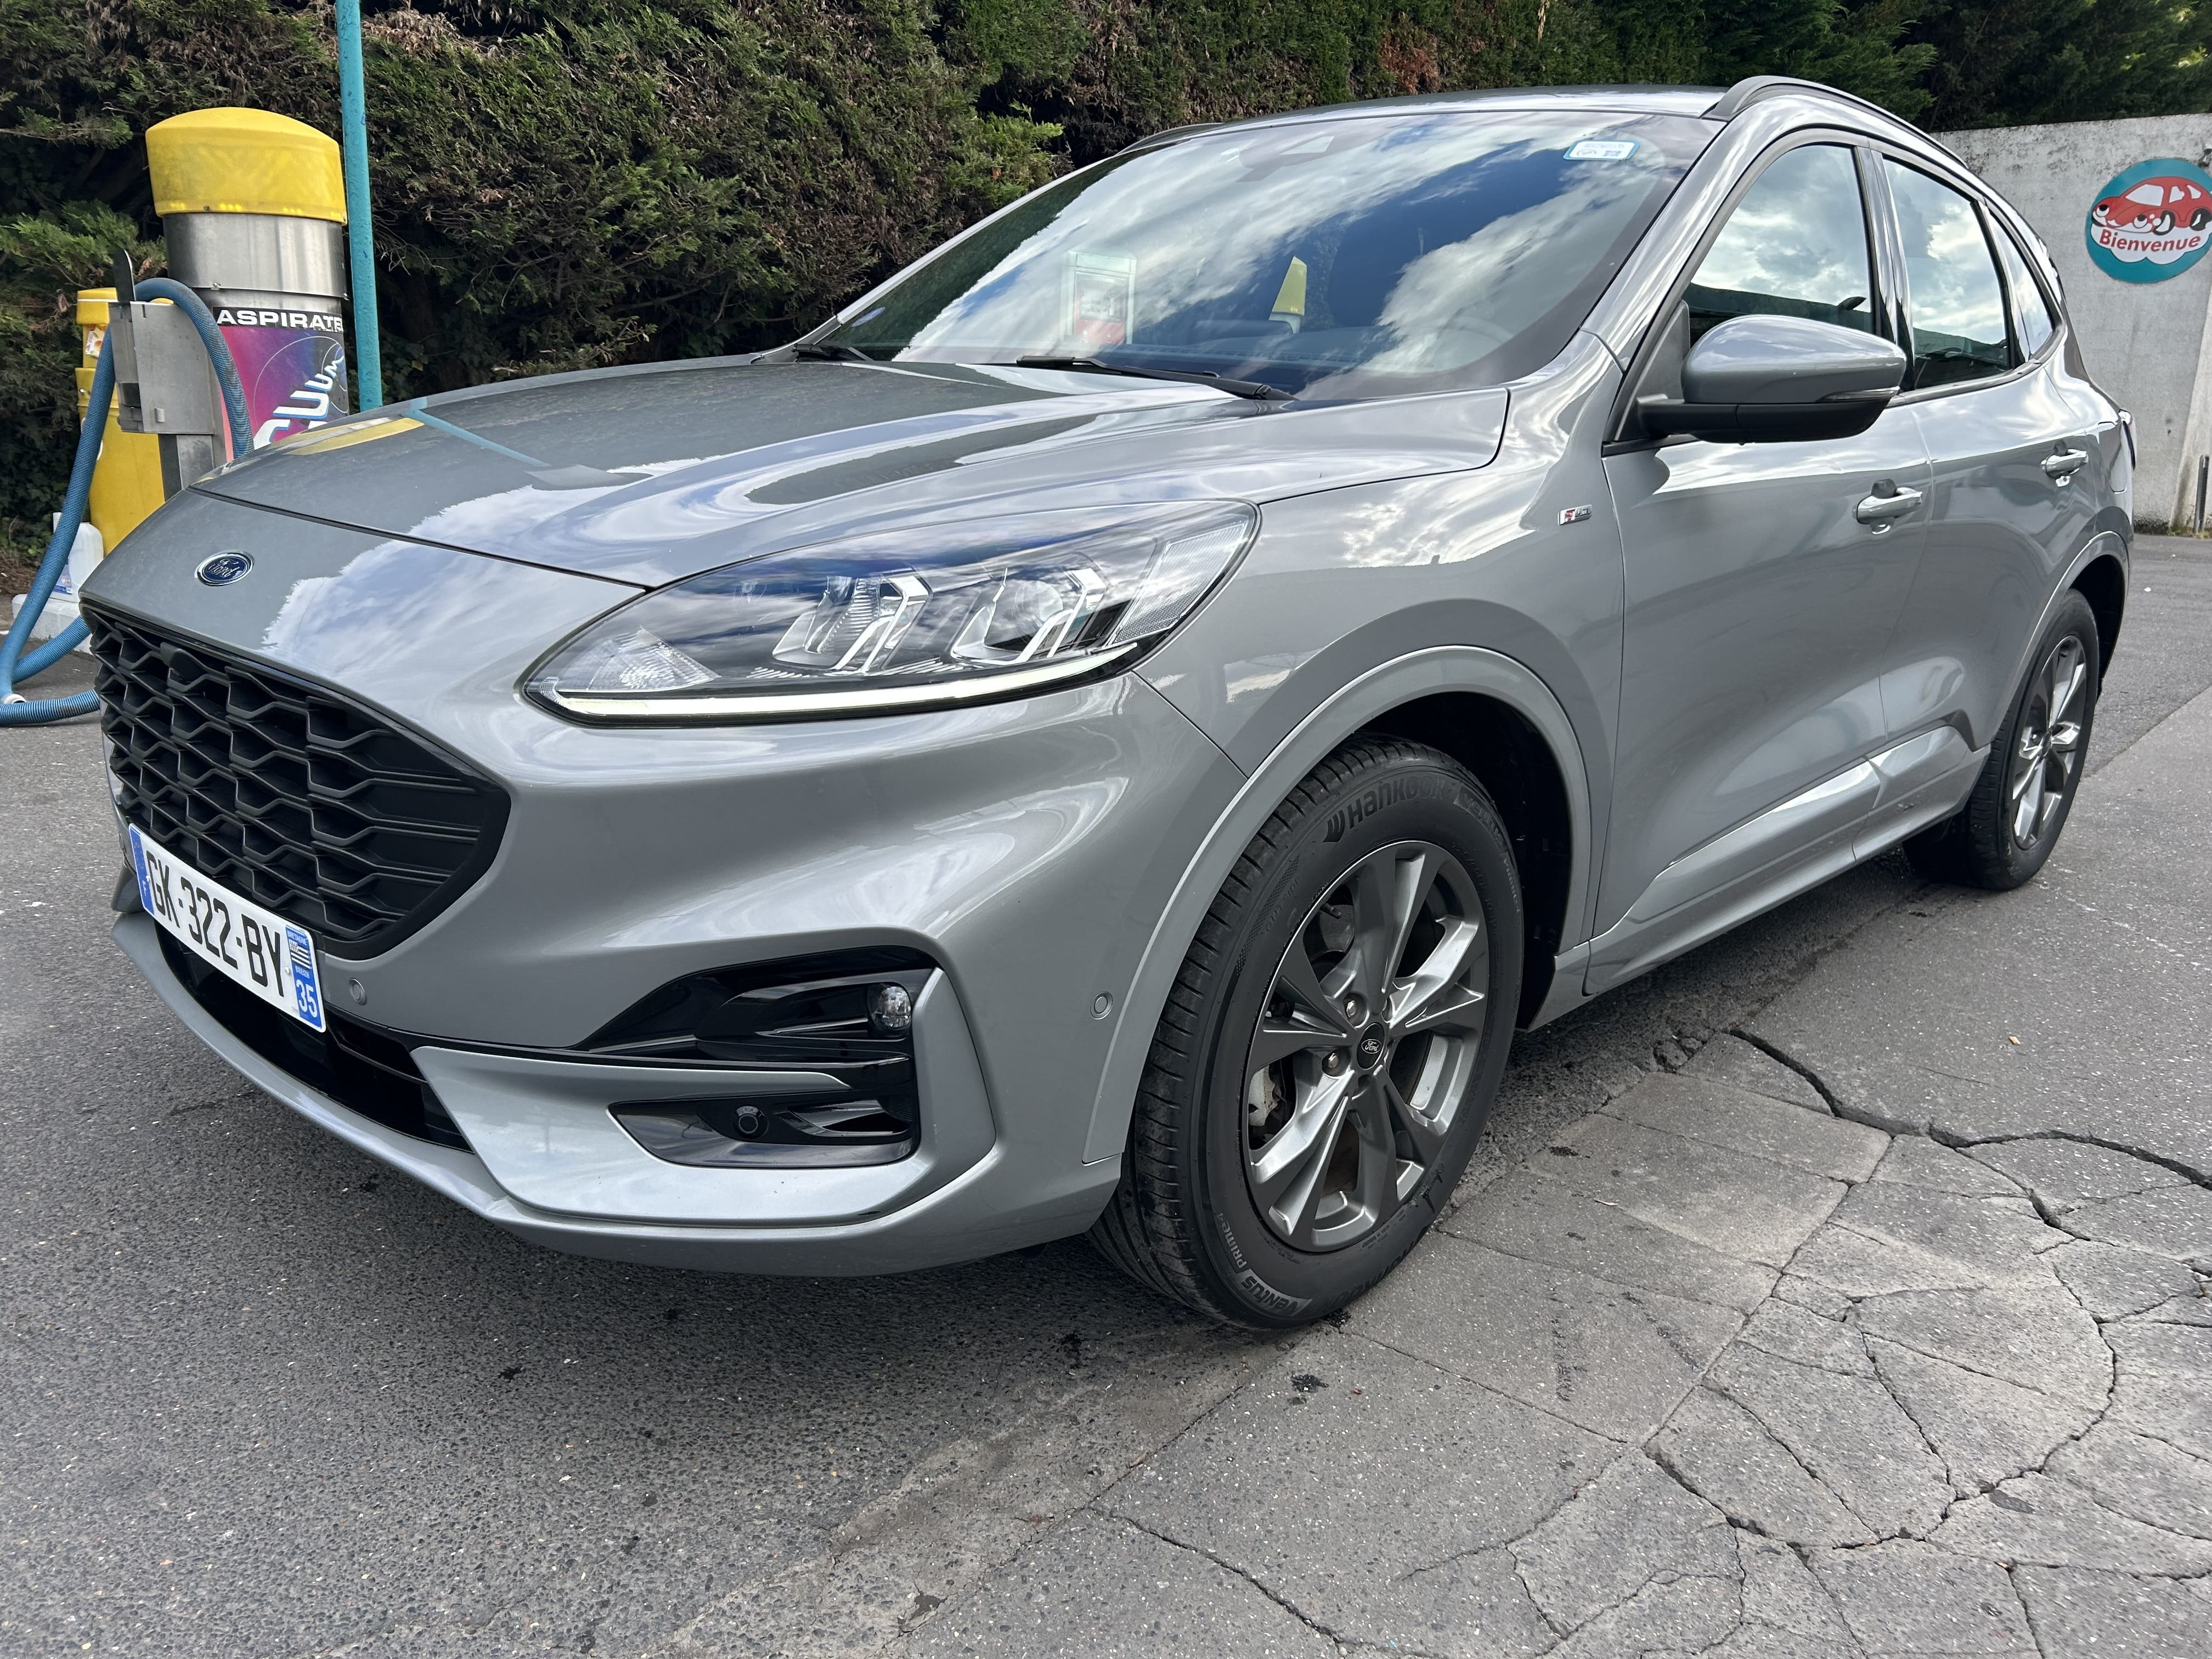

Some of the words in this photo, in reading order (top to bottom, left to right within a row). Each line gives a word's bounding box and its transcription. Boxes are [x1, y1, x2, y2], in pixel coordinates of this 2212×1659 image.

[2099, 229, 2201, 252] Bienvenue
[208, 558, 239, 578] Ford
[296, 979, 318, 1018] 35
[1364, 1040, 1379, 1051] Ford
